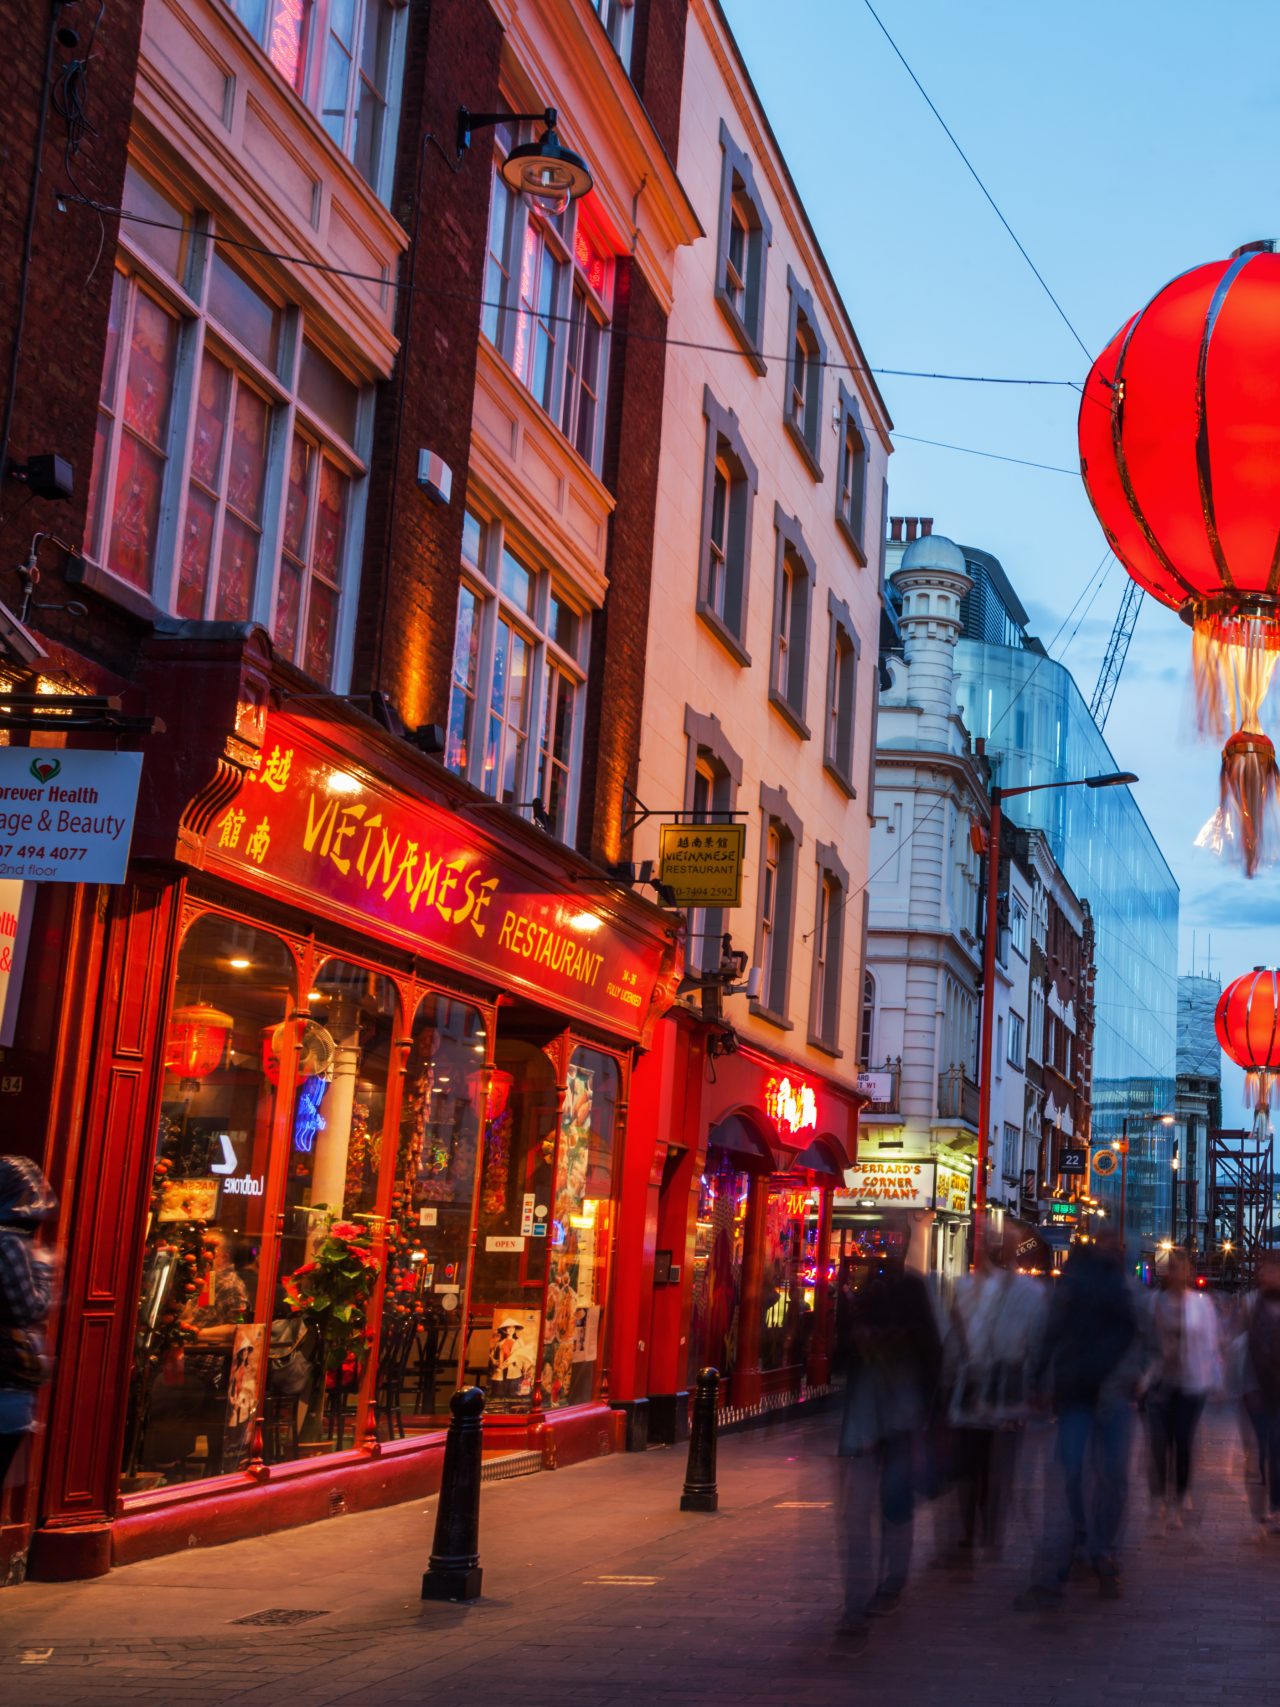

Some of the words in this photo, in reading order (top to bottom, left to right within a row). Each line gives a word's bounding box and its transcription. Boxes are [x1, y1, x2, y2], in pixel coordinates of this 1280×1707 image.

[49, 786, 98, 804] Health
[37, 809, 52, 832] &
[57, 810, 126, 841] Beauty
[17, 845, 45, 859] 494
[49, 847, 88, 861] 4077
[666, 851, 735, 862] VIETNAMESE
[0, 863, 25, 876] 2nd
[28, 864, 58, 877] floor
[666, 865, 734, 874] RESTAURANT
[303, 793, 499, 937] VIETNAMESE
[498, 910, 604, 986] RESTAURANT
[674, 887, 708, 897] 0-7494
[1065, 1155, 1079, 1165] 22
[863, 1177, 913, 1188] CORNER
[835, 1187, 919, 1200] RESTAURANT
[1053, 1214, 1065, 1222] HK
[495, 1240, 516, 1248] OPEN
